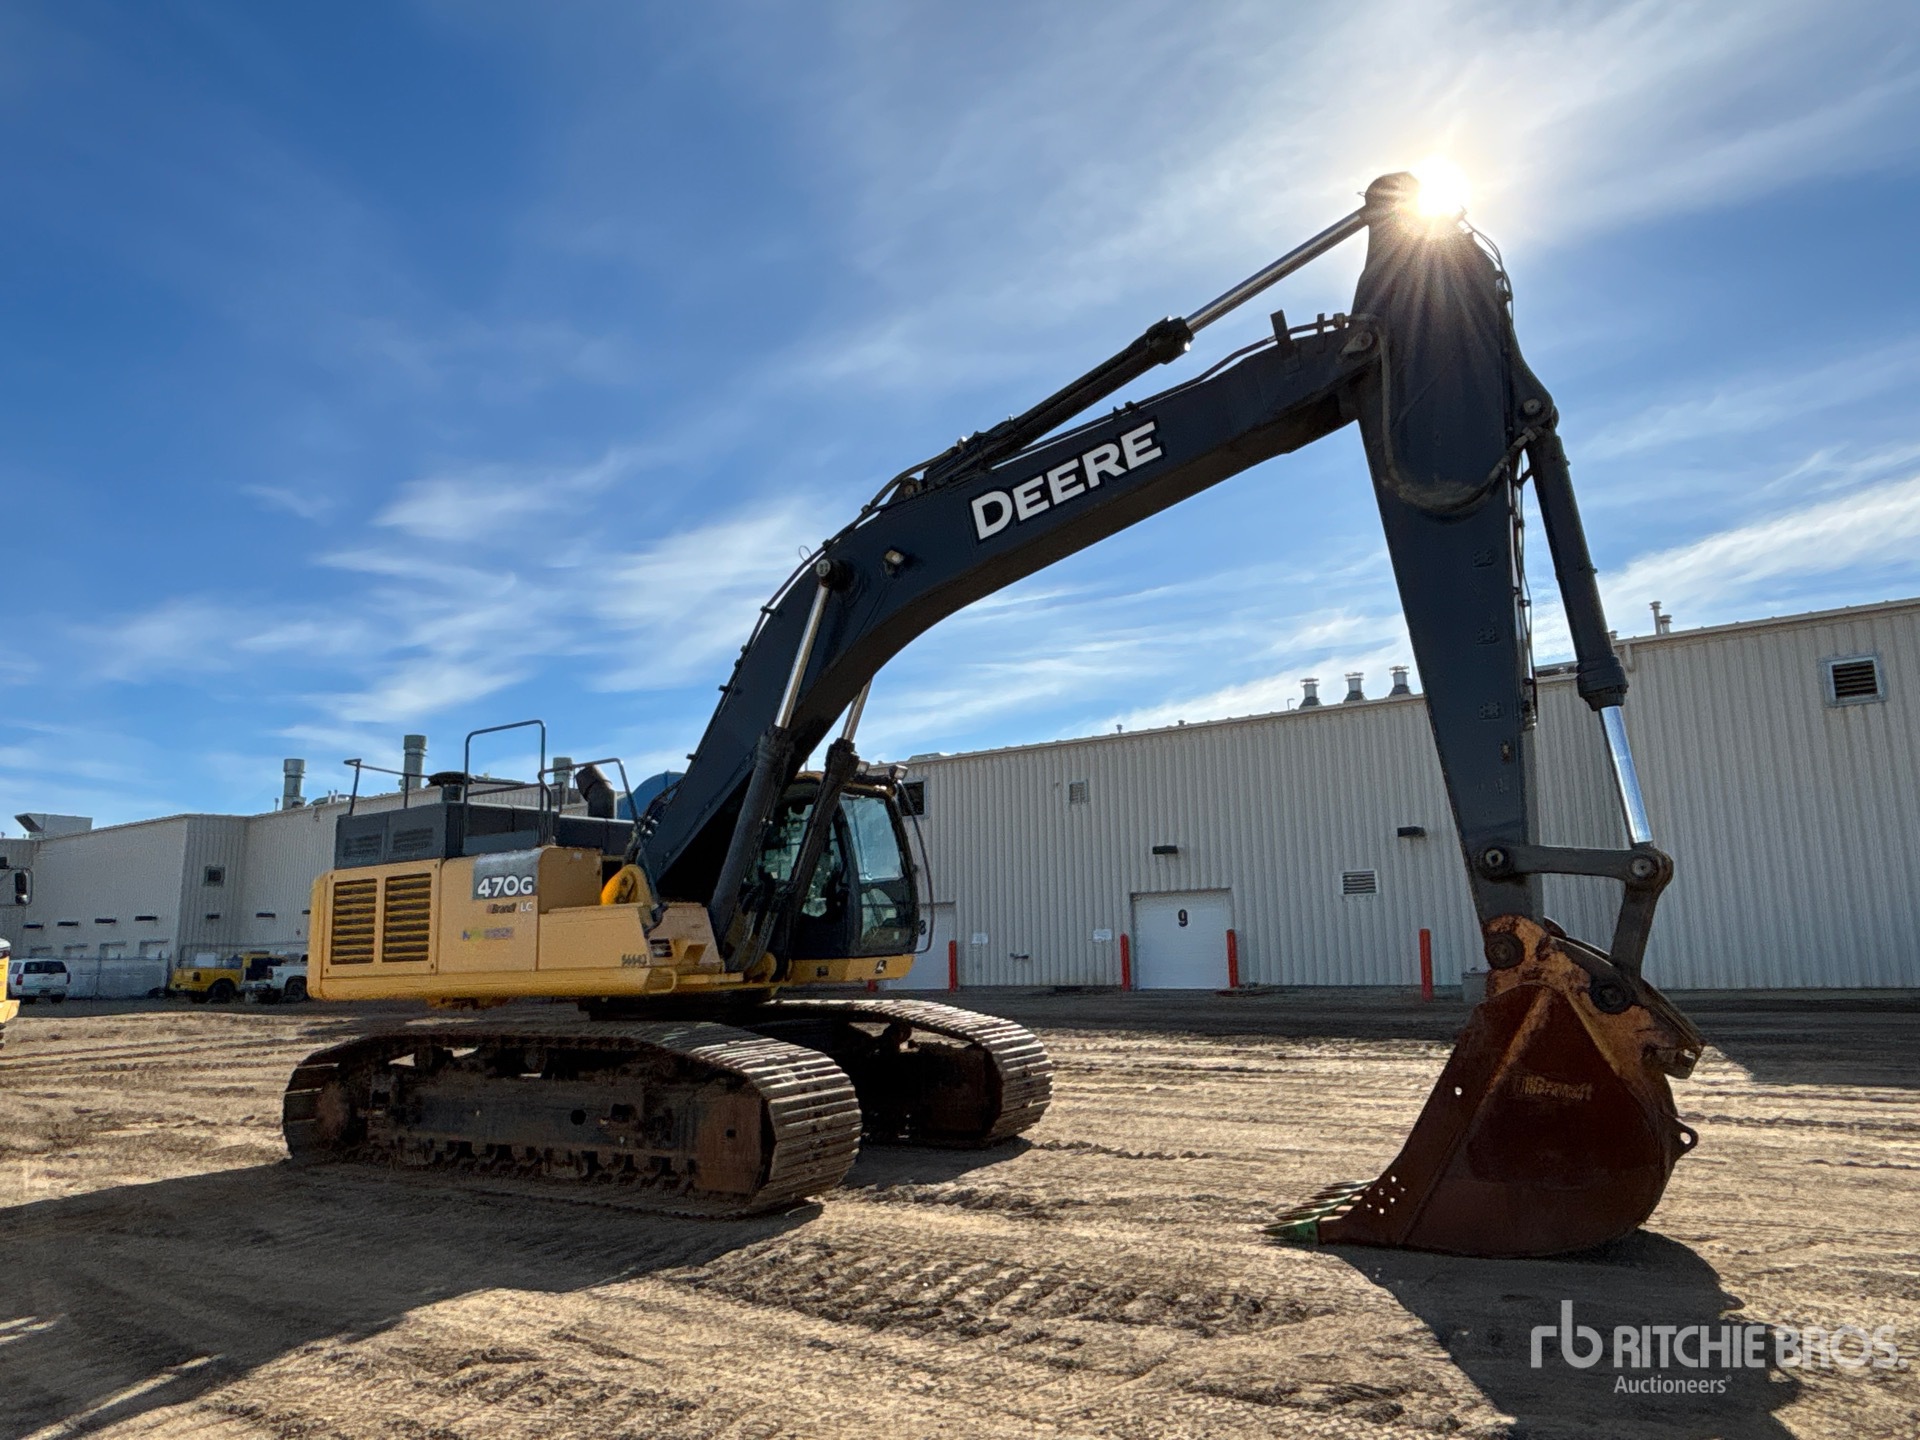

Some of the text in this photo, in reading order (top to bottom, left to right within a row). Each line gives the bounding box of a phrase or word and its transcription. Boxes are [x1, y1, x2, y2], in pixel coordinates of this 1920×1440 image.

[971, 421, 1162, 540] DEERE
[477, 875, 533, 897] 470G
[520, 901, 533, 912] LC
[1178, 909, 1188, 927] 9
[919, 920, 926, 935] 8
